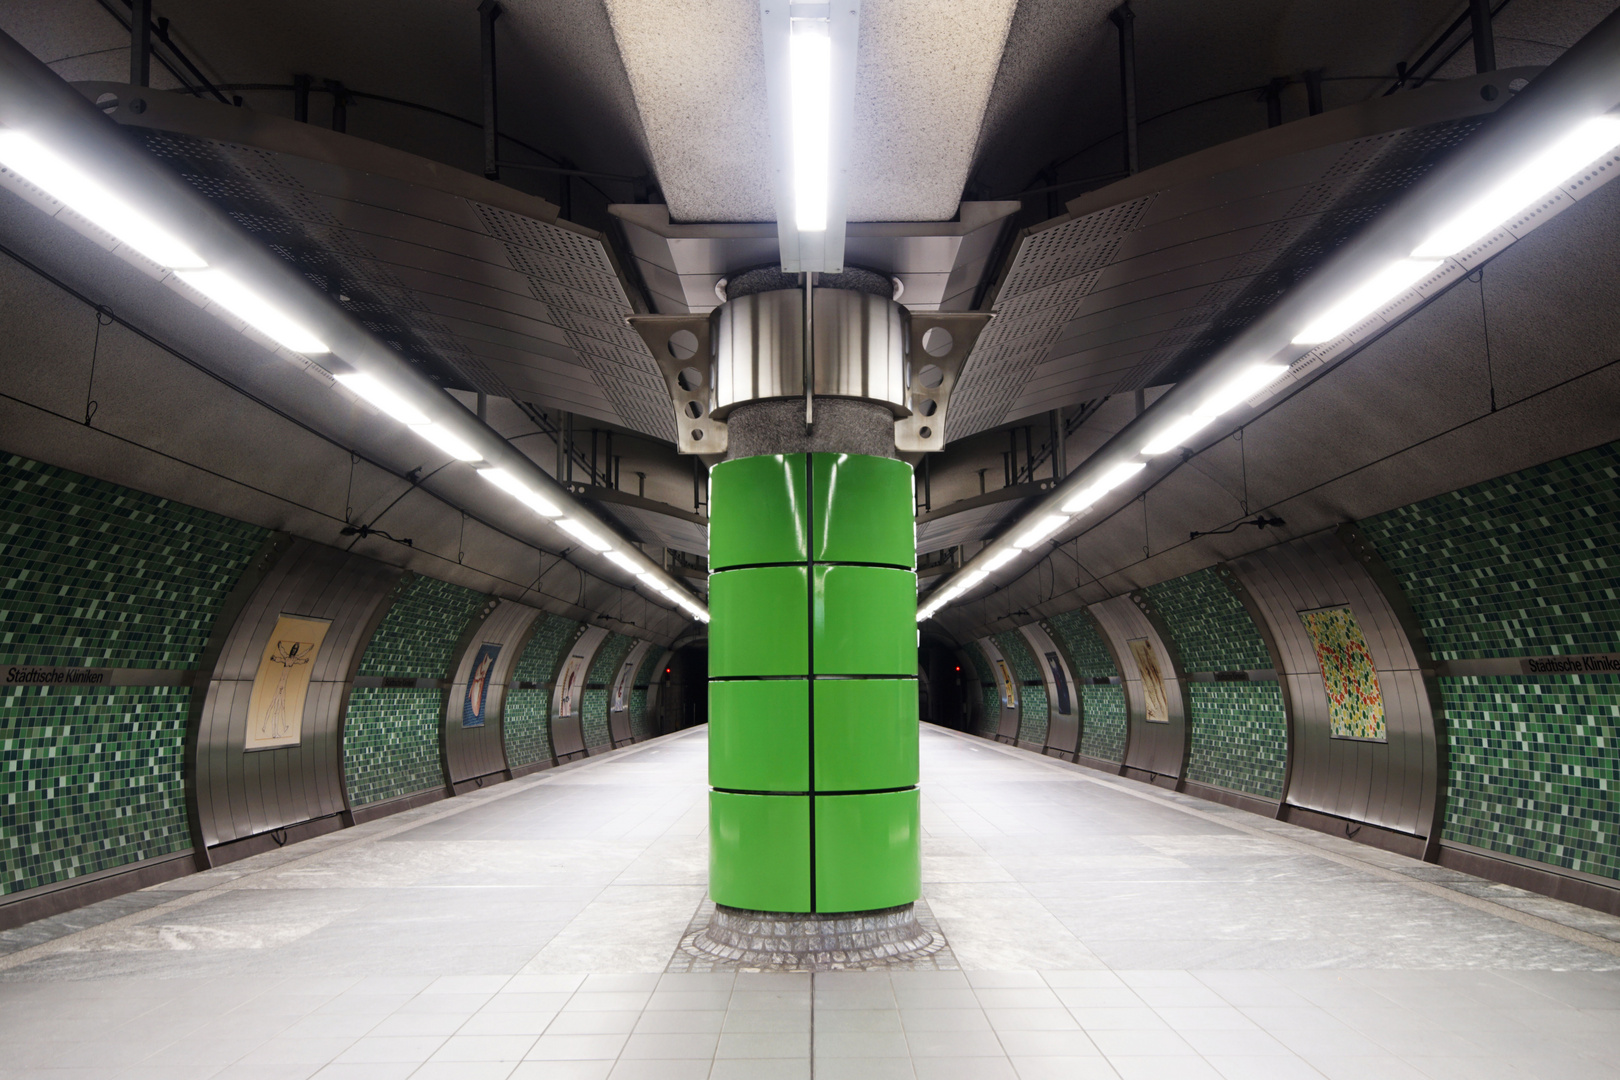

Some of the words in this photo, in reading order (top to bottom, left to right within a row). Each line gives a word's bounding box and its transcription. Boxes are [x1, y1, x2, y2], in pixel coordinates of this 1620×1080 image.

[1528, 657, 1583, 673] Städtische
[1582, 655, 1620, 671] Klinike
[6, 667, 64, 683] Städtische
[65, 668, 104, 684] Kliniken
